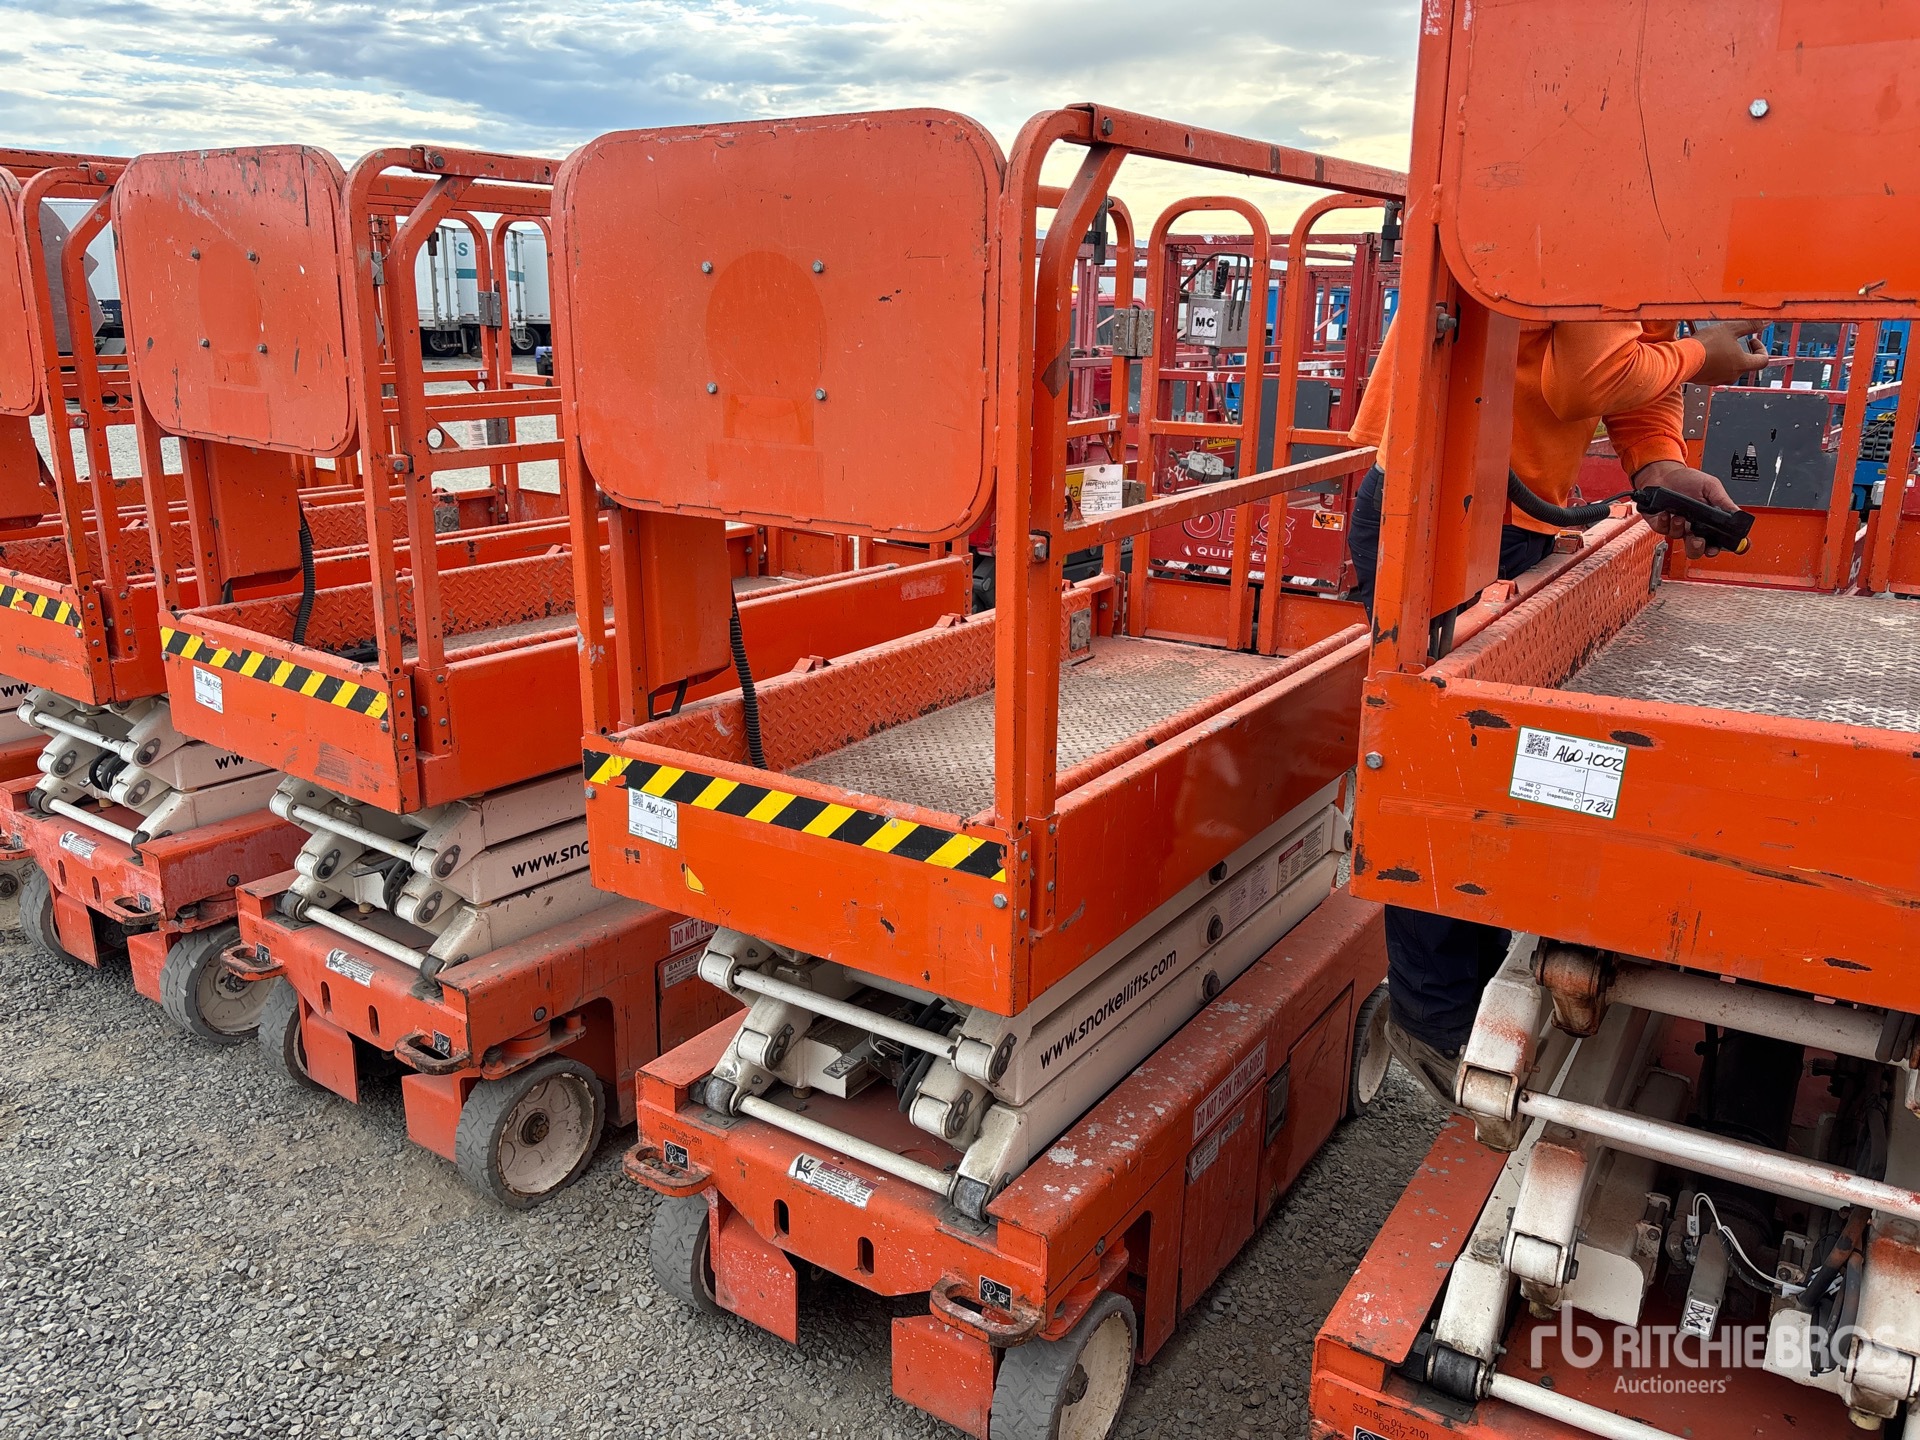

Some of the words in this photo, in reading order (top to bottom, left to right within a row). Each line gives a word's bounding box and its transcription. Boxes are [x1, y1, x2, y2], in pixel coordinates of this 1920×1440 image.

[1195, 317, 1215, 328] MC
[1558, 788, 1574, 796] Fluids
[685, 921, 698, 941] NOT
[668, 953, 698, 972] BATTERY
[1040, 949, 1177, 1070] www.snorkellifts.com
[1206, 1094, 1217, 1123] NOT
